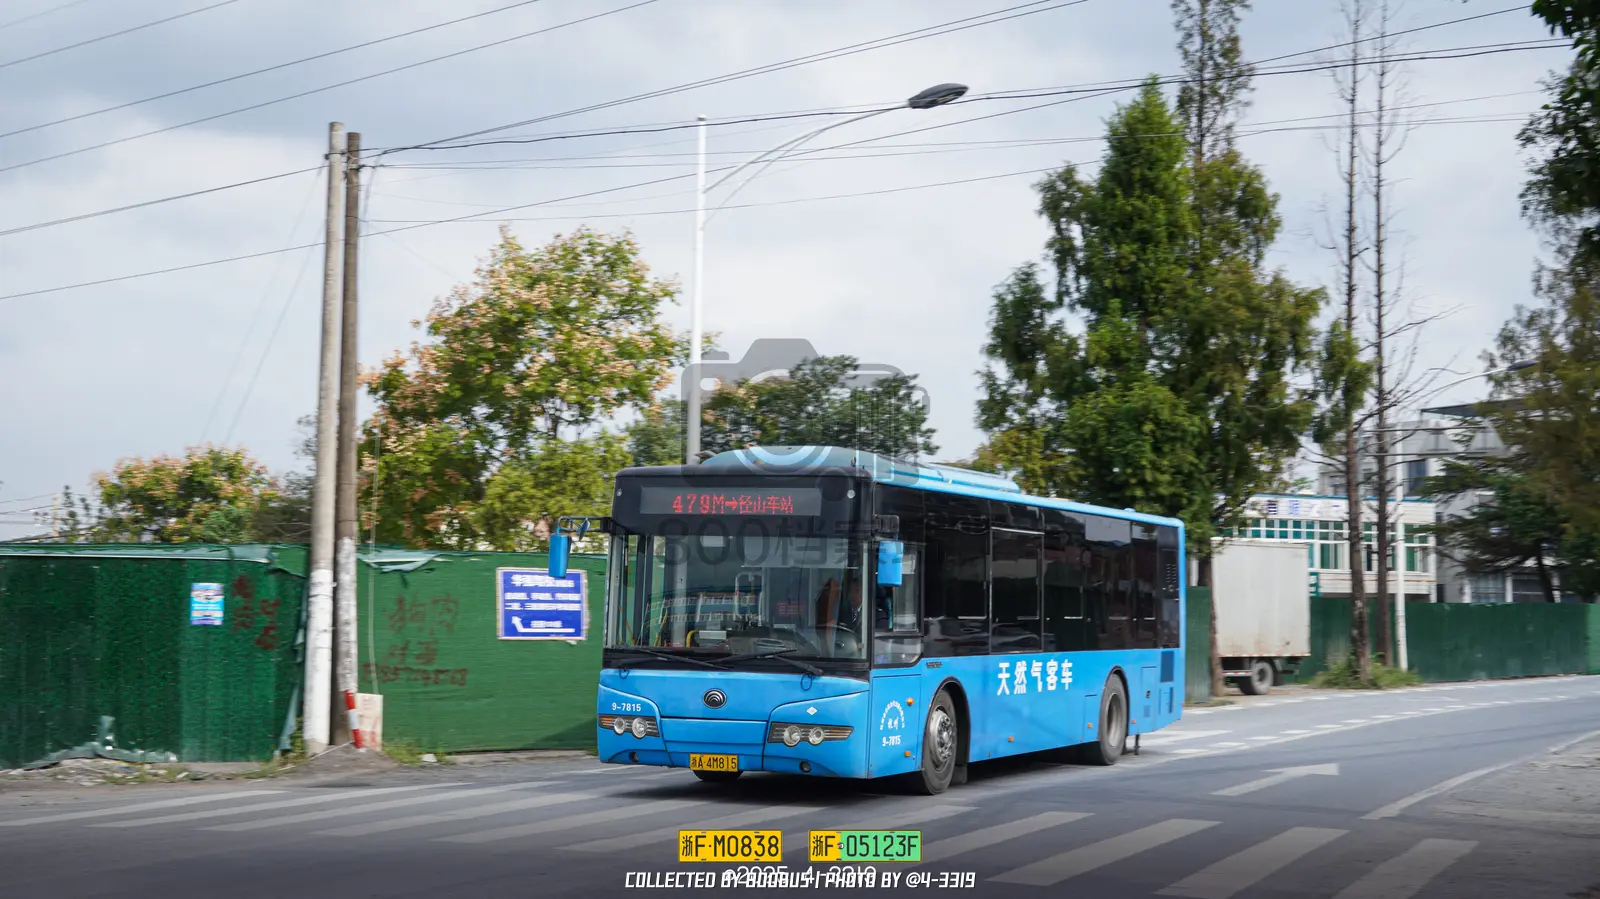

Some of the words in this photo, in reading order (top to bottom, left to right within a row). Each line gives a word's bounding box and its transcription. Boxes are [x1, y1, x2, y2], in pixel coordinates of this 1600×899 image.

[672, 494, 725, 514] 479M
[739, 494, 794, 514] 径山车站
[997, 659, 1073, 696] 天然气客车
[612, 702, 642, 712] 9-7815
